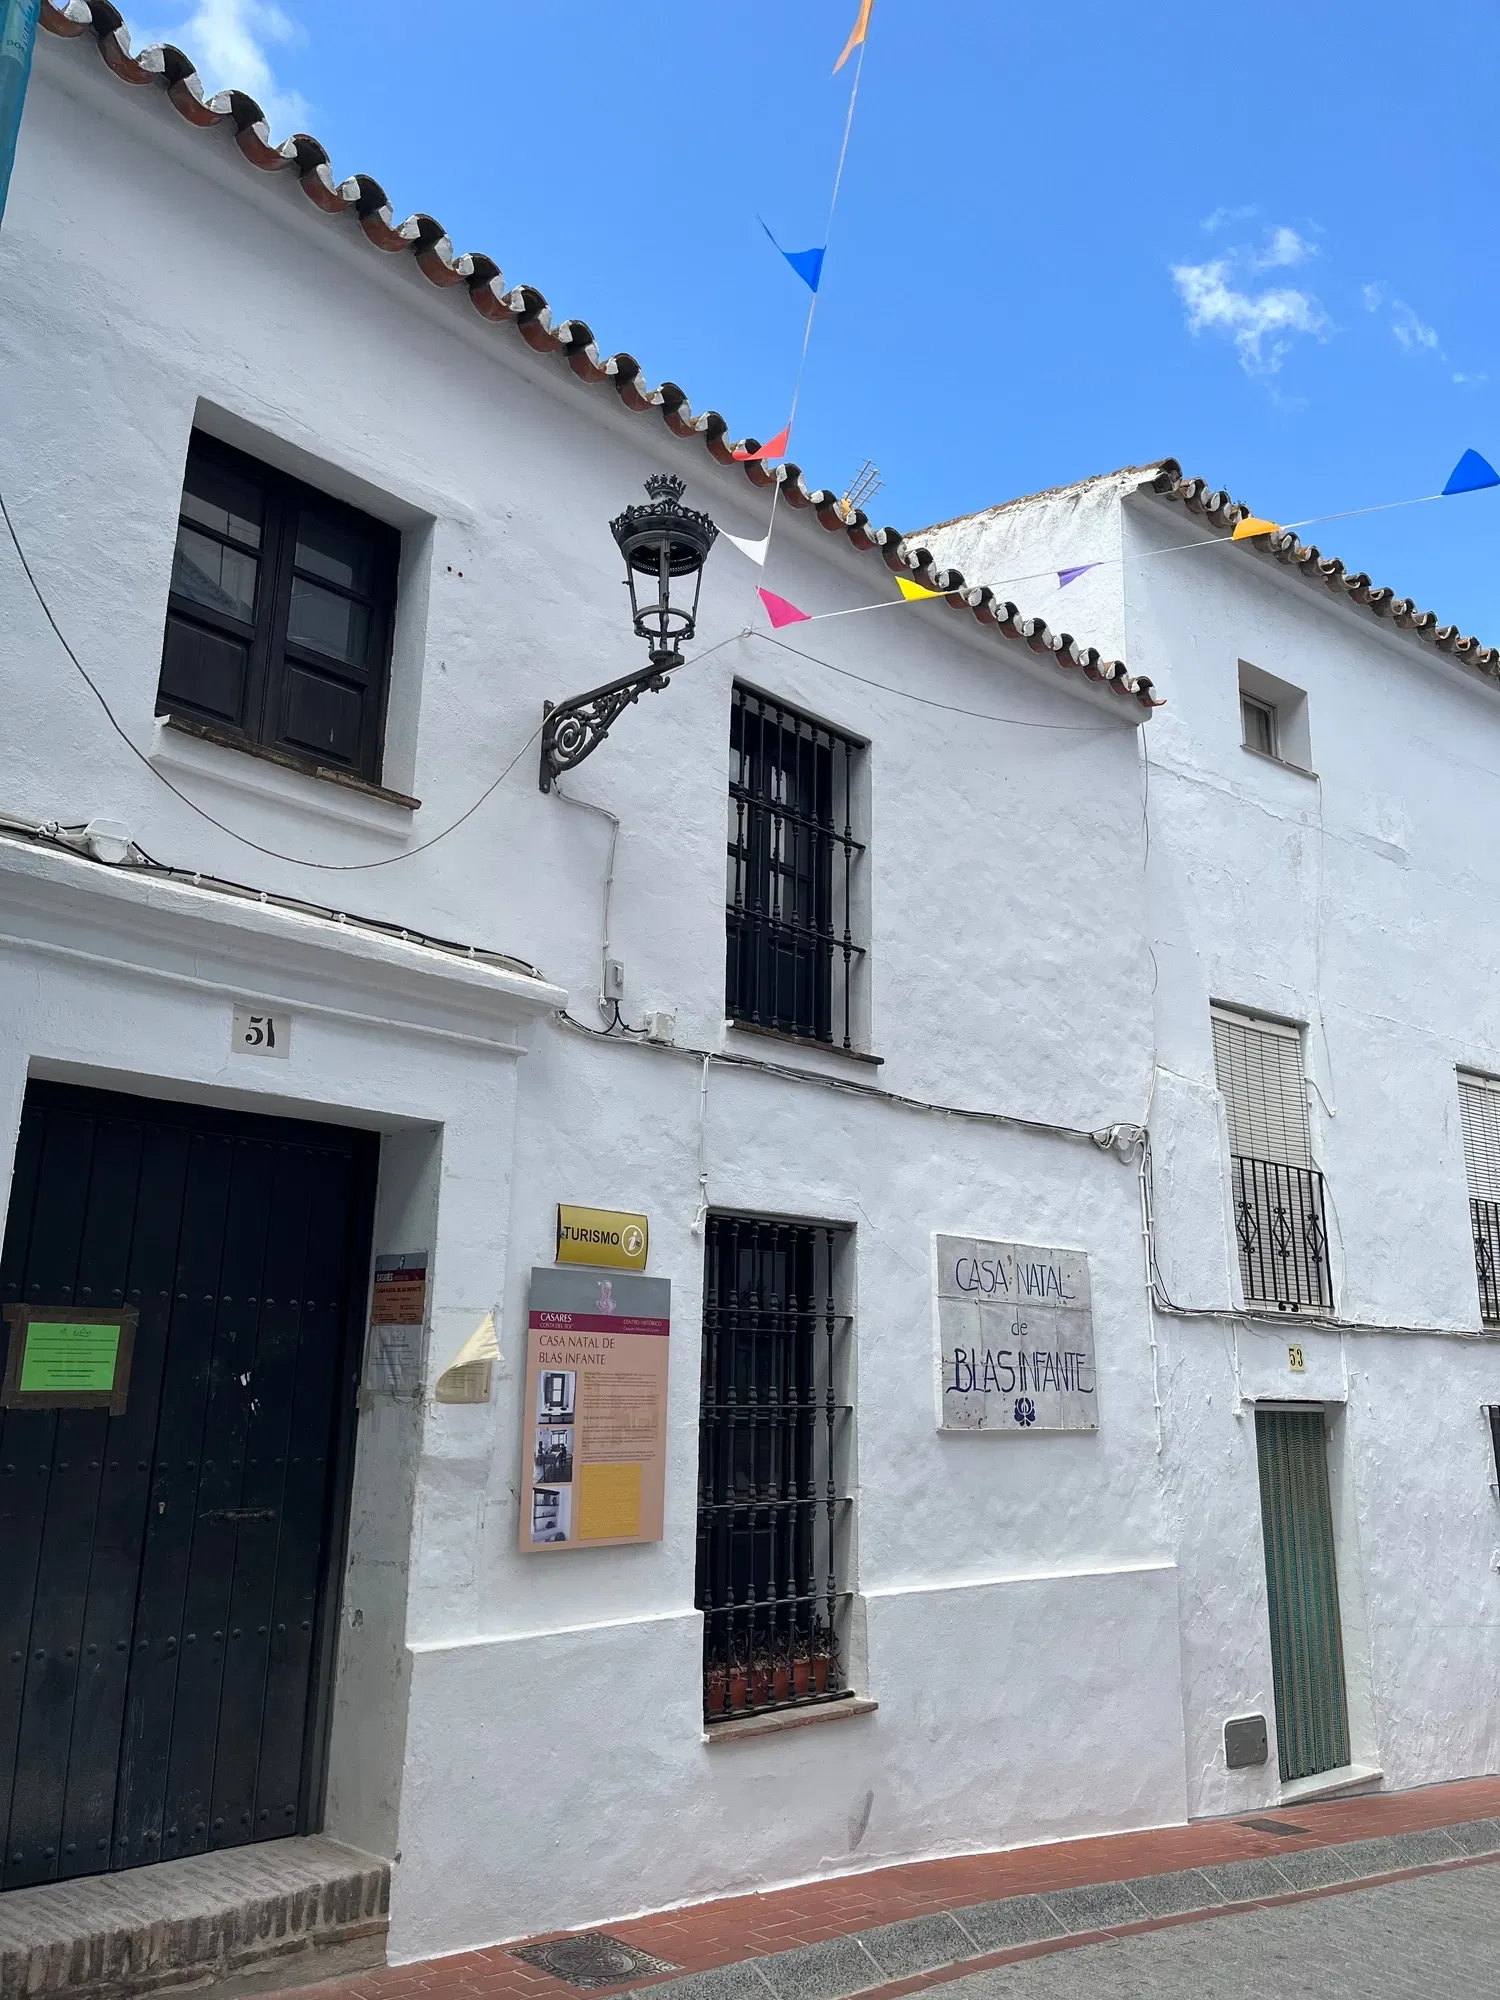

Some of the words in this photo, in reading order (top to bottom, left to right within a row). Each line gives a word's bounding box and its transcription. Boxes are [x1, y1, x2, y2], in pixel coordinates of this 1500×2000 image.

[245, 1016, 275, 1048] 51
[563, 1226, 620, 1246] TURISMO
[955, 1258, 1009, 1293] CASA
[1016, 1263, 1076, 1299] NATAL
[540, 1312, 572, 1323] CASARES
[1011, 1307, 1028, 1336] de
[539, 1335, 566, 1347] CASA
[568, 1336, 599, 1348] NATAL
[602, 1337, 615, 1349] DE
[539, 1351, 563, 1364] BLAS
[565, 1352, 606, 1365] INFANTE
[1288, 1347, 1304, 1367] 53
[945, 1347, 1016, 1393] BLAS
[1018, 1351, 1094, 1394] INFANTE
